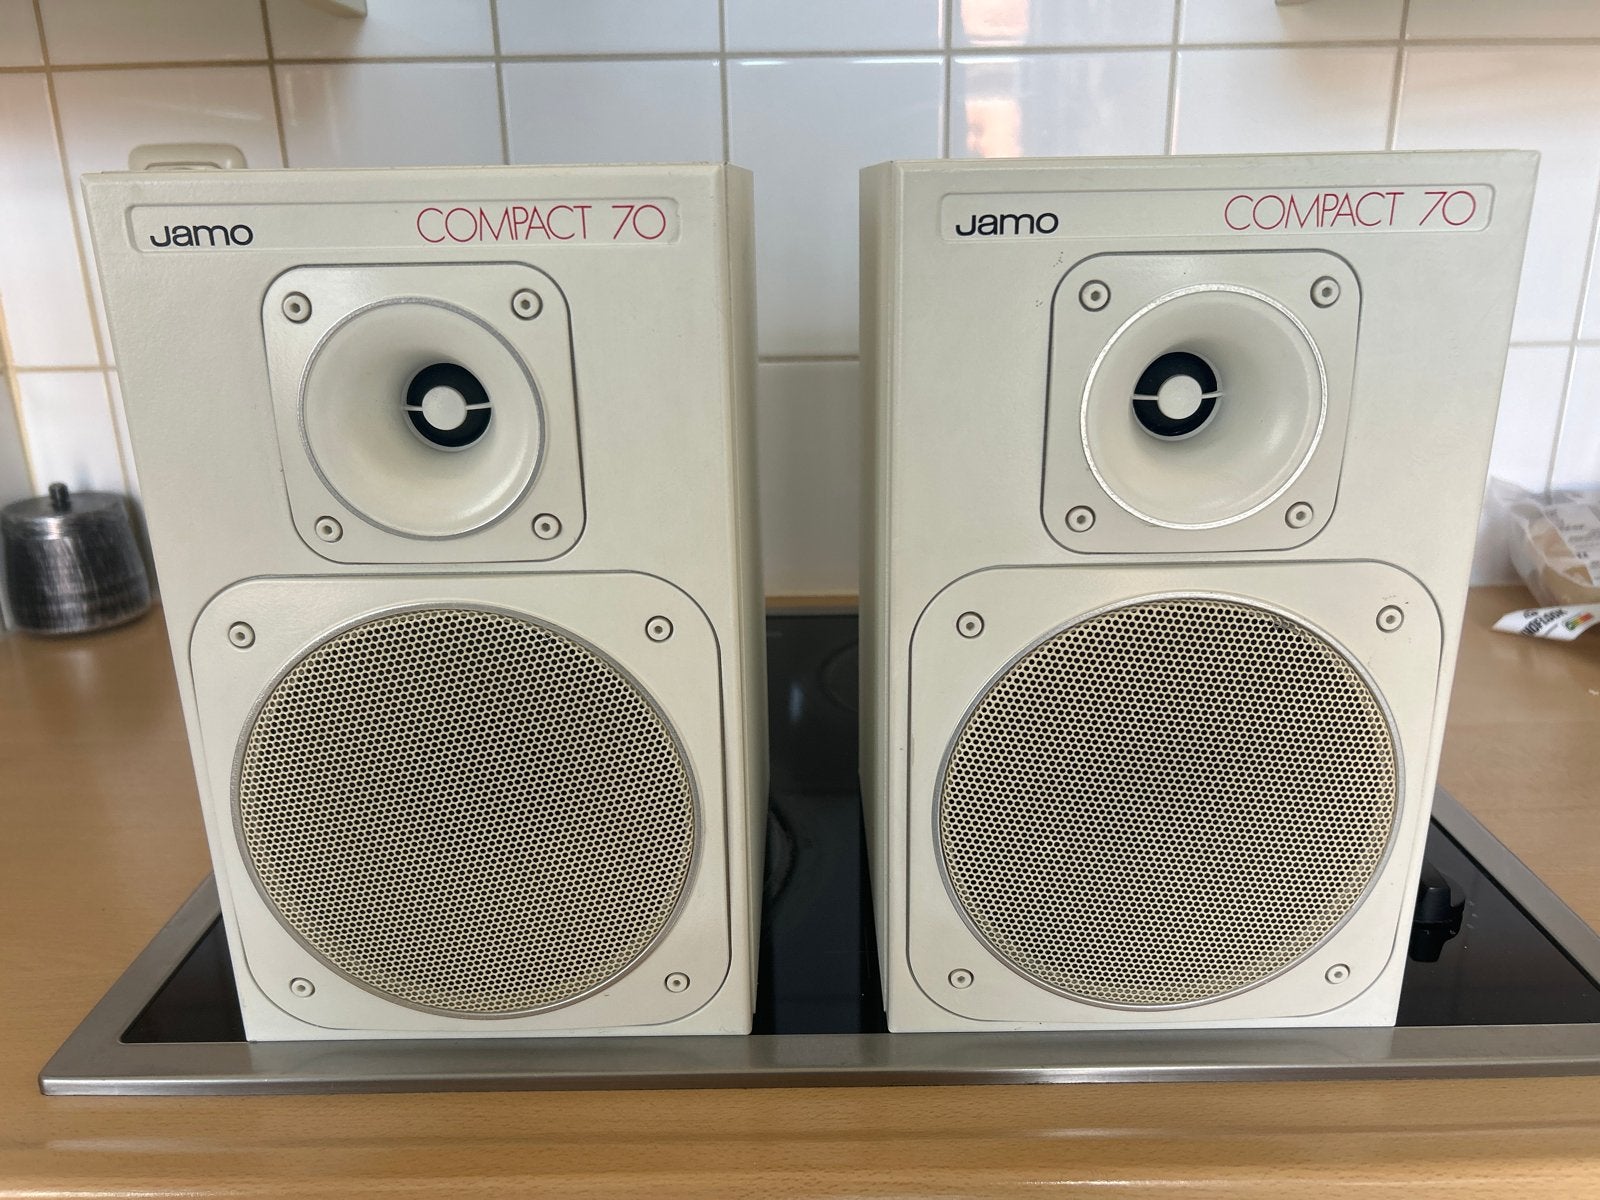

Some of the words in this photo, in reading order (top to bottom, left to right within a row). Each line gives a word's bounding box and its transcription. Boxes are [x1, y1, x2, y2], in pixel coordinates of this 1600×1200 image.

[416, 204, 592, 243] COMPACT
[612, 203, 667, 240] 70
[1224, 191, 1404, 230] COMPACT
[1418, 190, 1476, 226] 70
